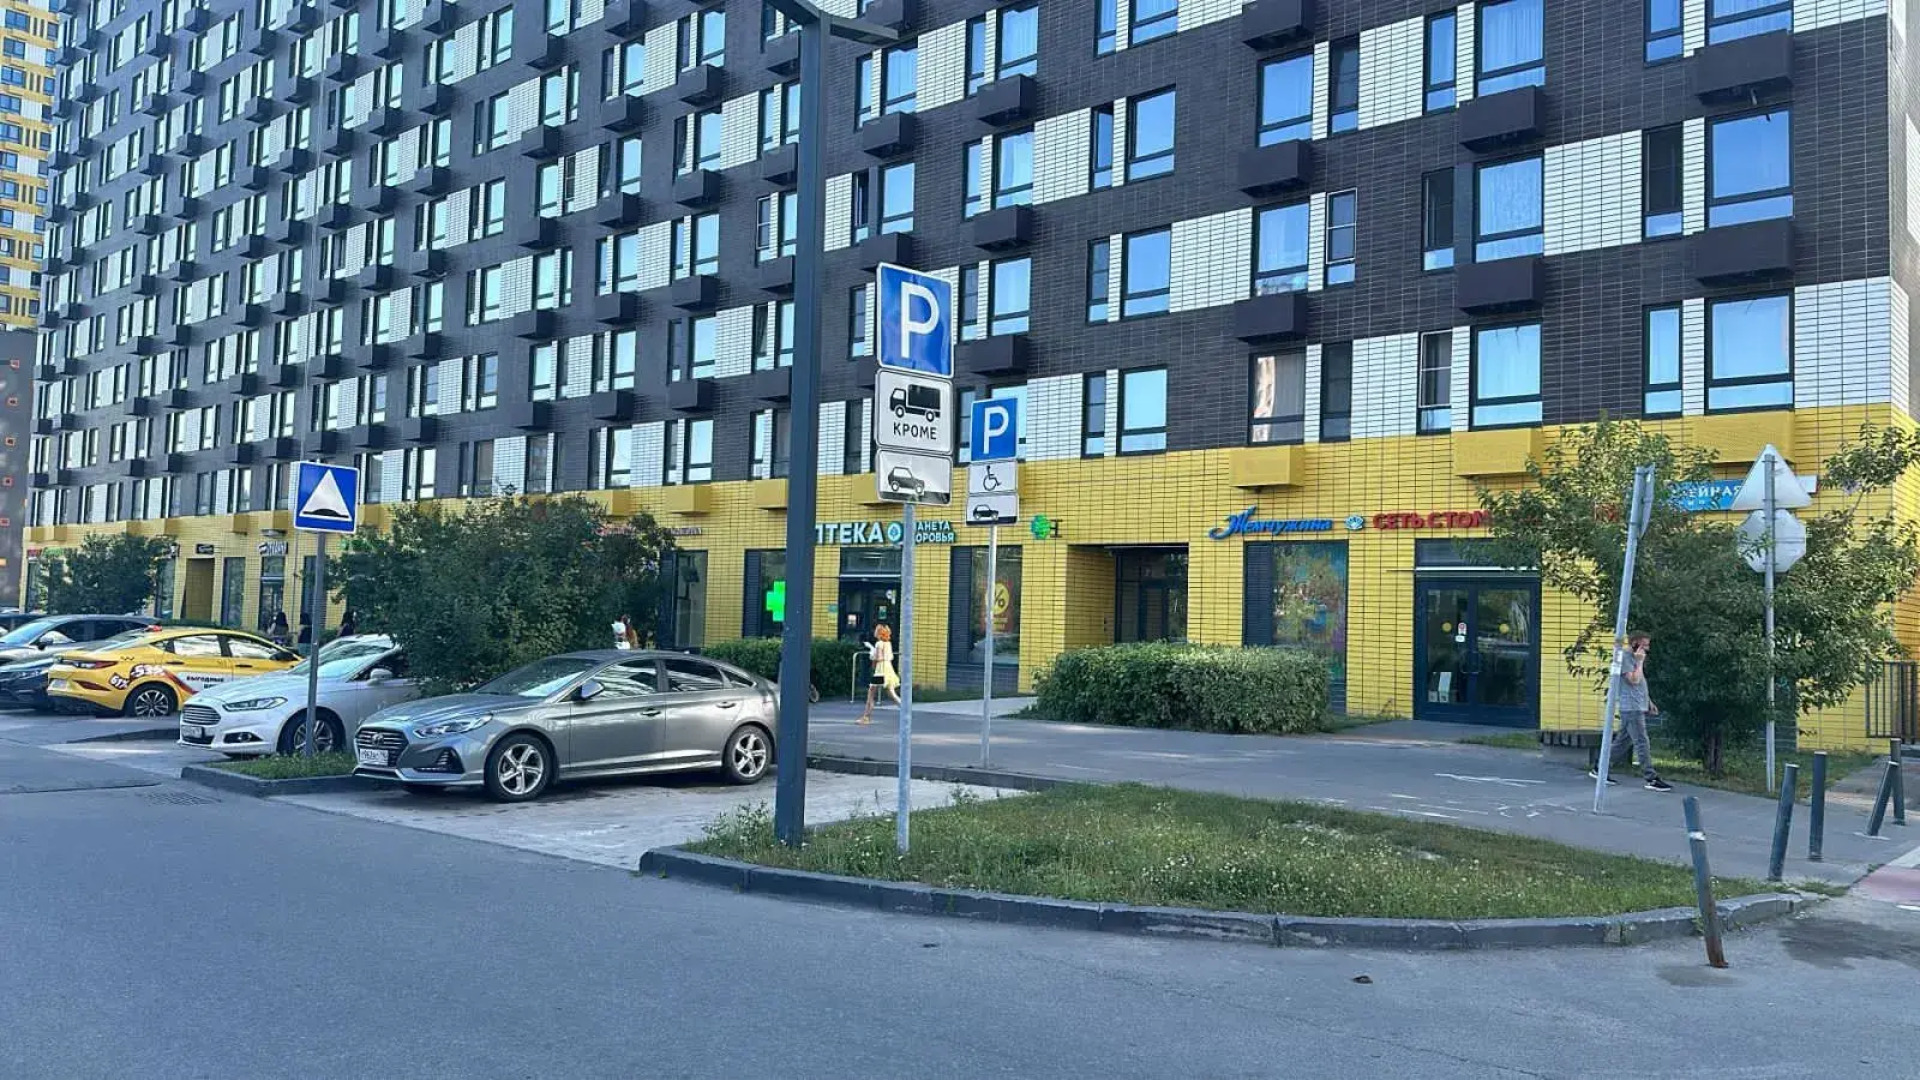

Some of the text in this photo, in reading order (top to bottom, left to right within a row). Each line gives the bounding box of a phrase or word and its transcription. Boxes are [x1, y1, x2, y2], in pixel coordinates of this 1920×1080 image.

[901, 281, 940, 359] P
[893, 421, 937, 440] КРОМЕ
[983, 406, 1009, 454] P
[916, 521, 950, 531] АНЕТА
[1373, 513, 1424, 529] СЕТЬ
[915, 532, 955, 543] ОРОВЬЯ
